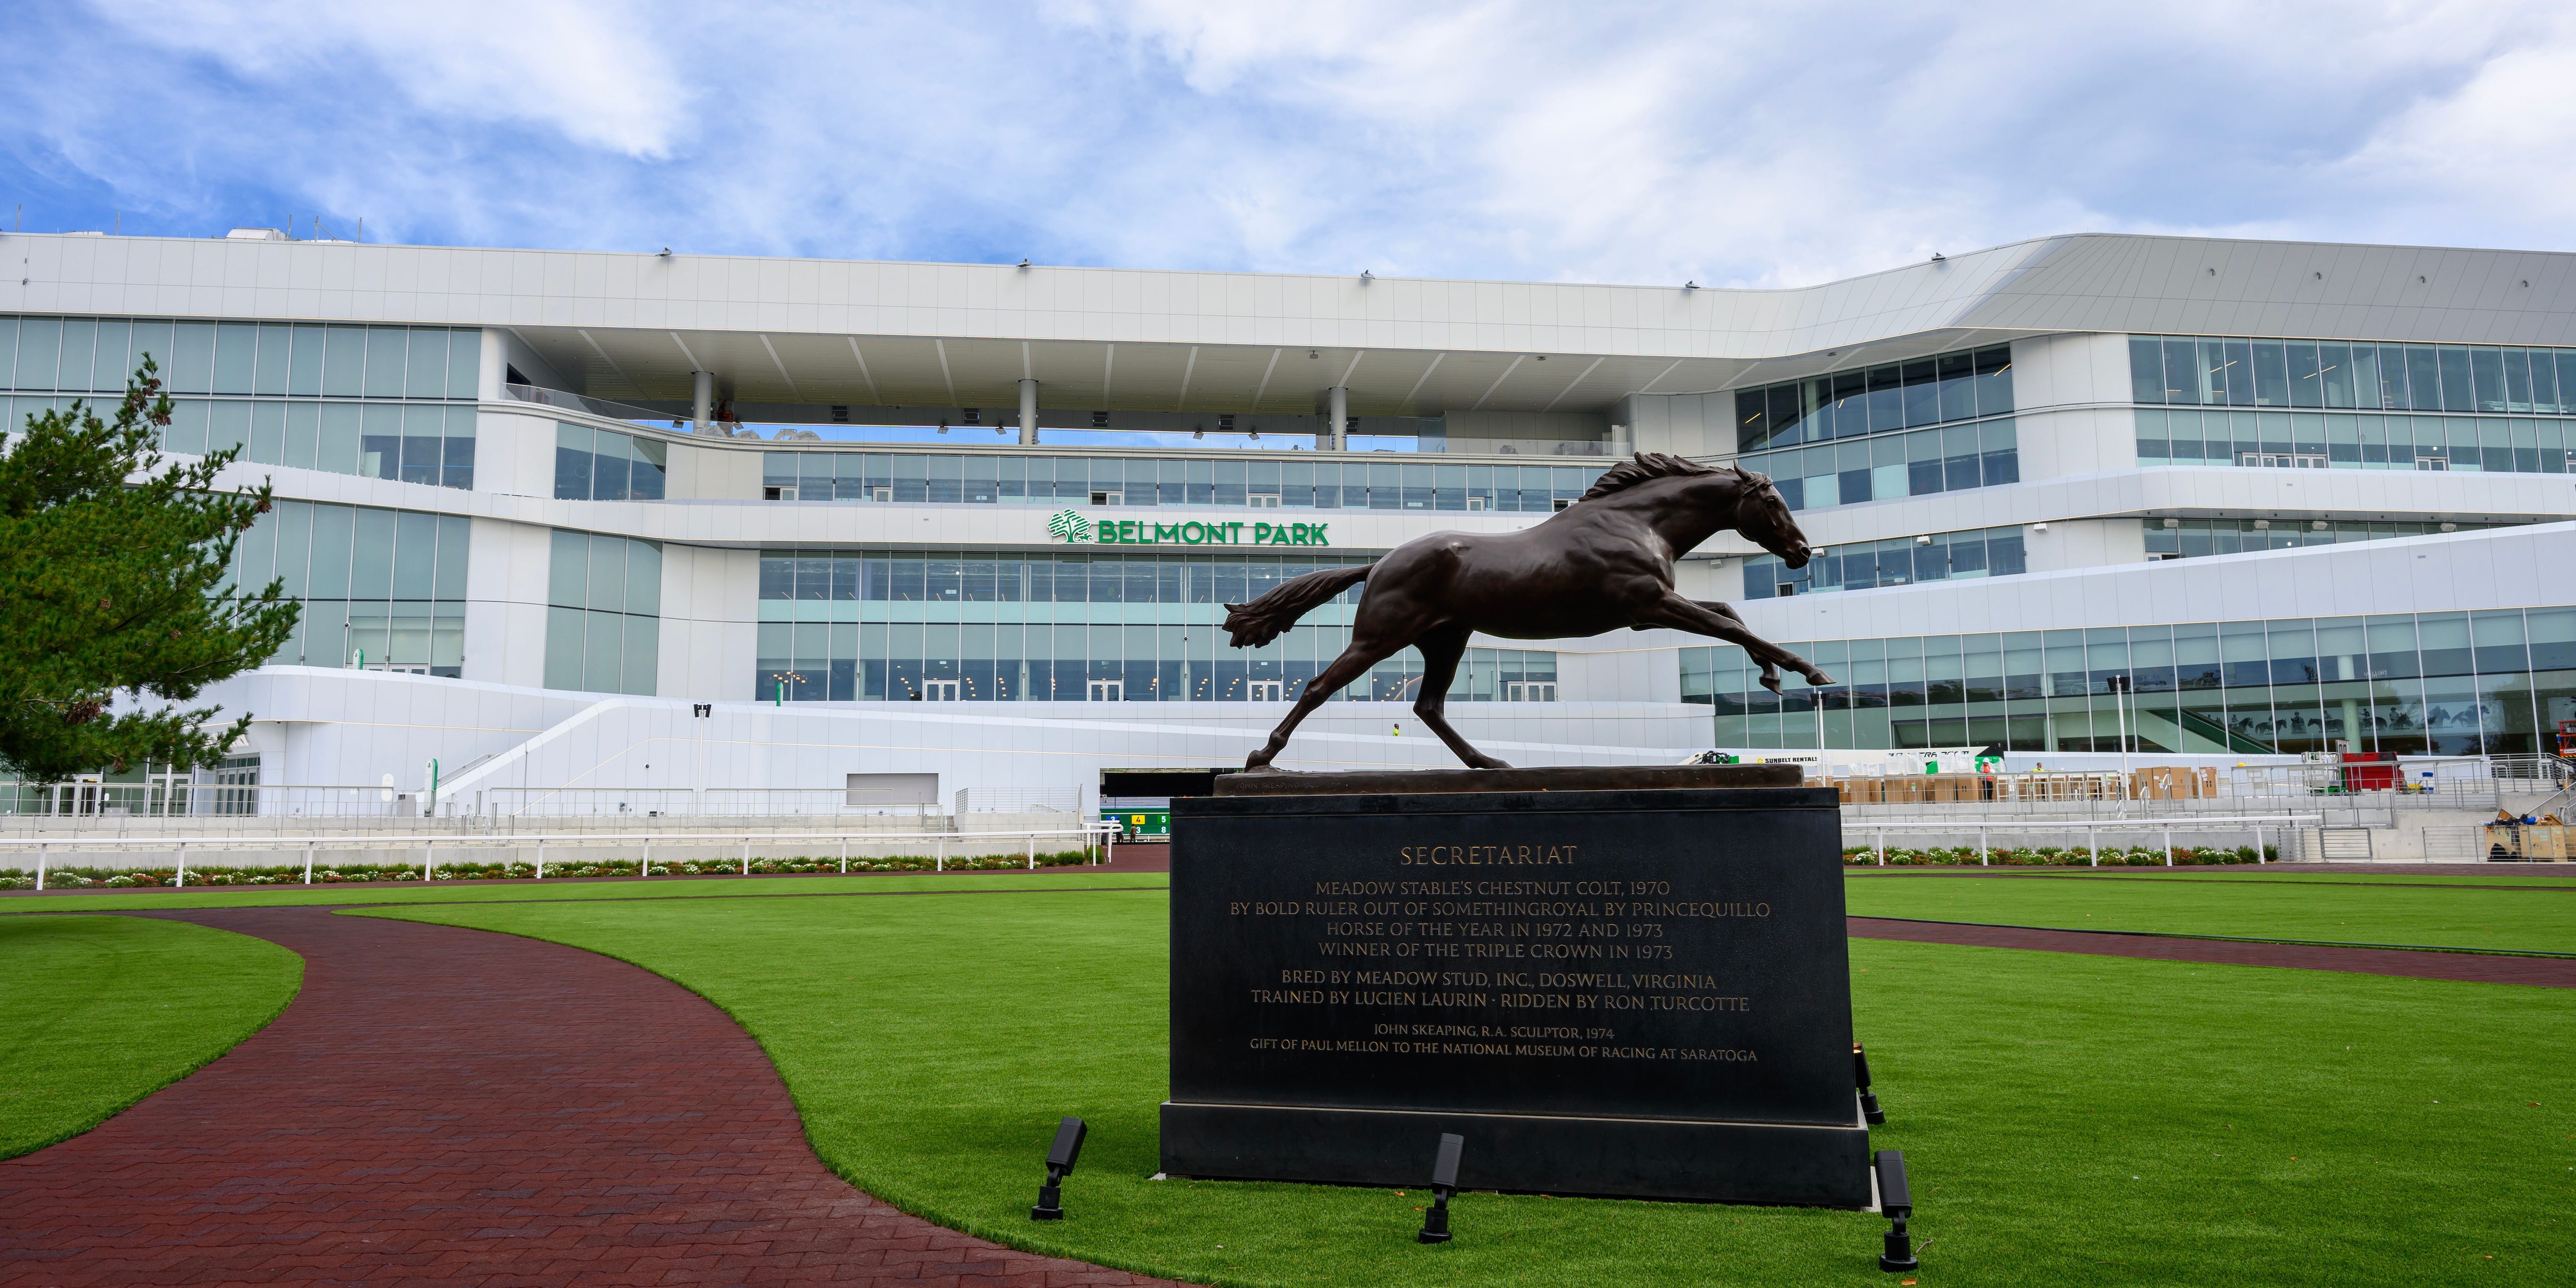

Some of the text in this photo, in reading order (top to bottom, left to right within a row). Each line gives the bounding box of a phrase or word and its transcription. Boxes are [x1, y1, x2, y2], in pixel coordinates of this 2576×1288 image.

[1098, 520, 1329, 546] BELMONT PARK
[1400, 845, 1578, 866] SECRETARIAT
[1316, 880, 1670, 897] MEADOW STABLE'S CHESTNUT COLT, 1970
[1230, 902, 1770, 918] BY BOLD RULER OUT OF SOMETHINGROYAL BY PRINCEQUILLO
[1327, 922, 1663, 938] HORSE OF THE YEAR IN 1972 AND 1973
[1318, 942, 1673, 959] WINNER OF THE TRIPLE CROWN IN 1973
[1282, 970, 1717, 990] BRED BY MEADOW STUD, INC., DOSWELL, VIRGINIA
[1251, 989, 1750, 1011] TRAINED BY LUCIEN LAURIN RIDDEN BY RON TURCOTTE
[1374, 1023, 1408, 1035] JOHN
[1412, 1024, 1479, 1038] SKEAPING,
[1511, 1026, 1583, 1040] SCULPTOR,
[1586, 1028, 1615, 1039] 1974
[1250, 1038, 1758, 1061] GIFT OF PAUL MELLON TO THE NATIONAL MUSEUM OF RACING AT SARATOGA
